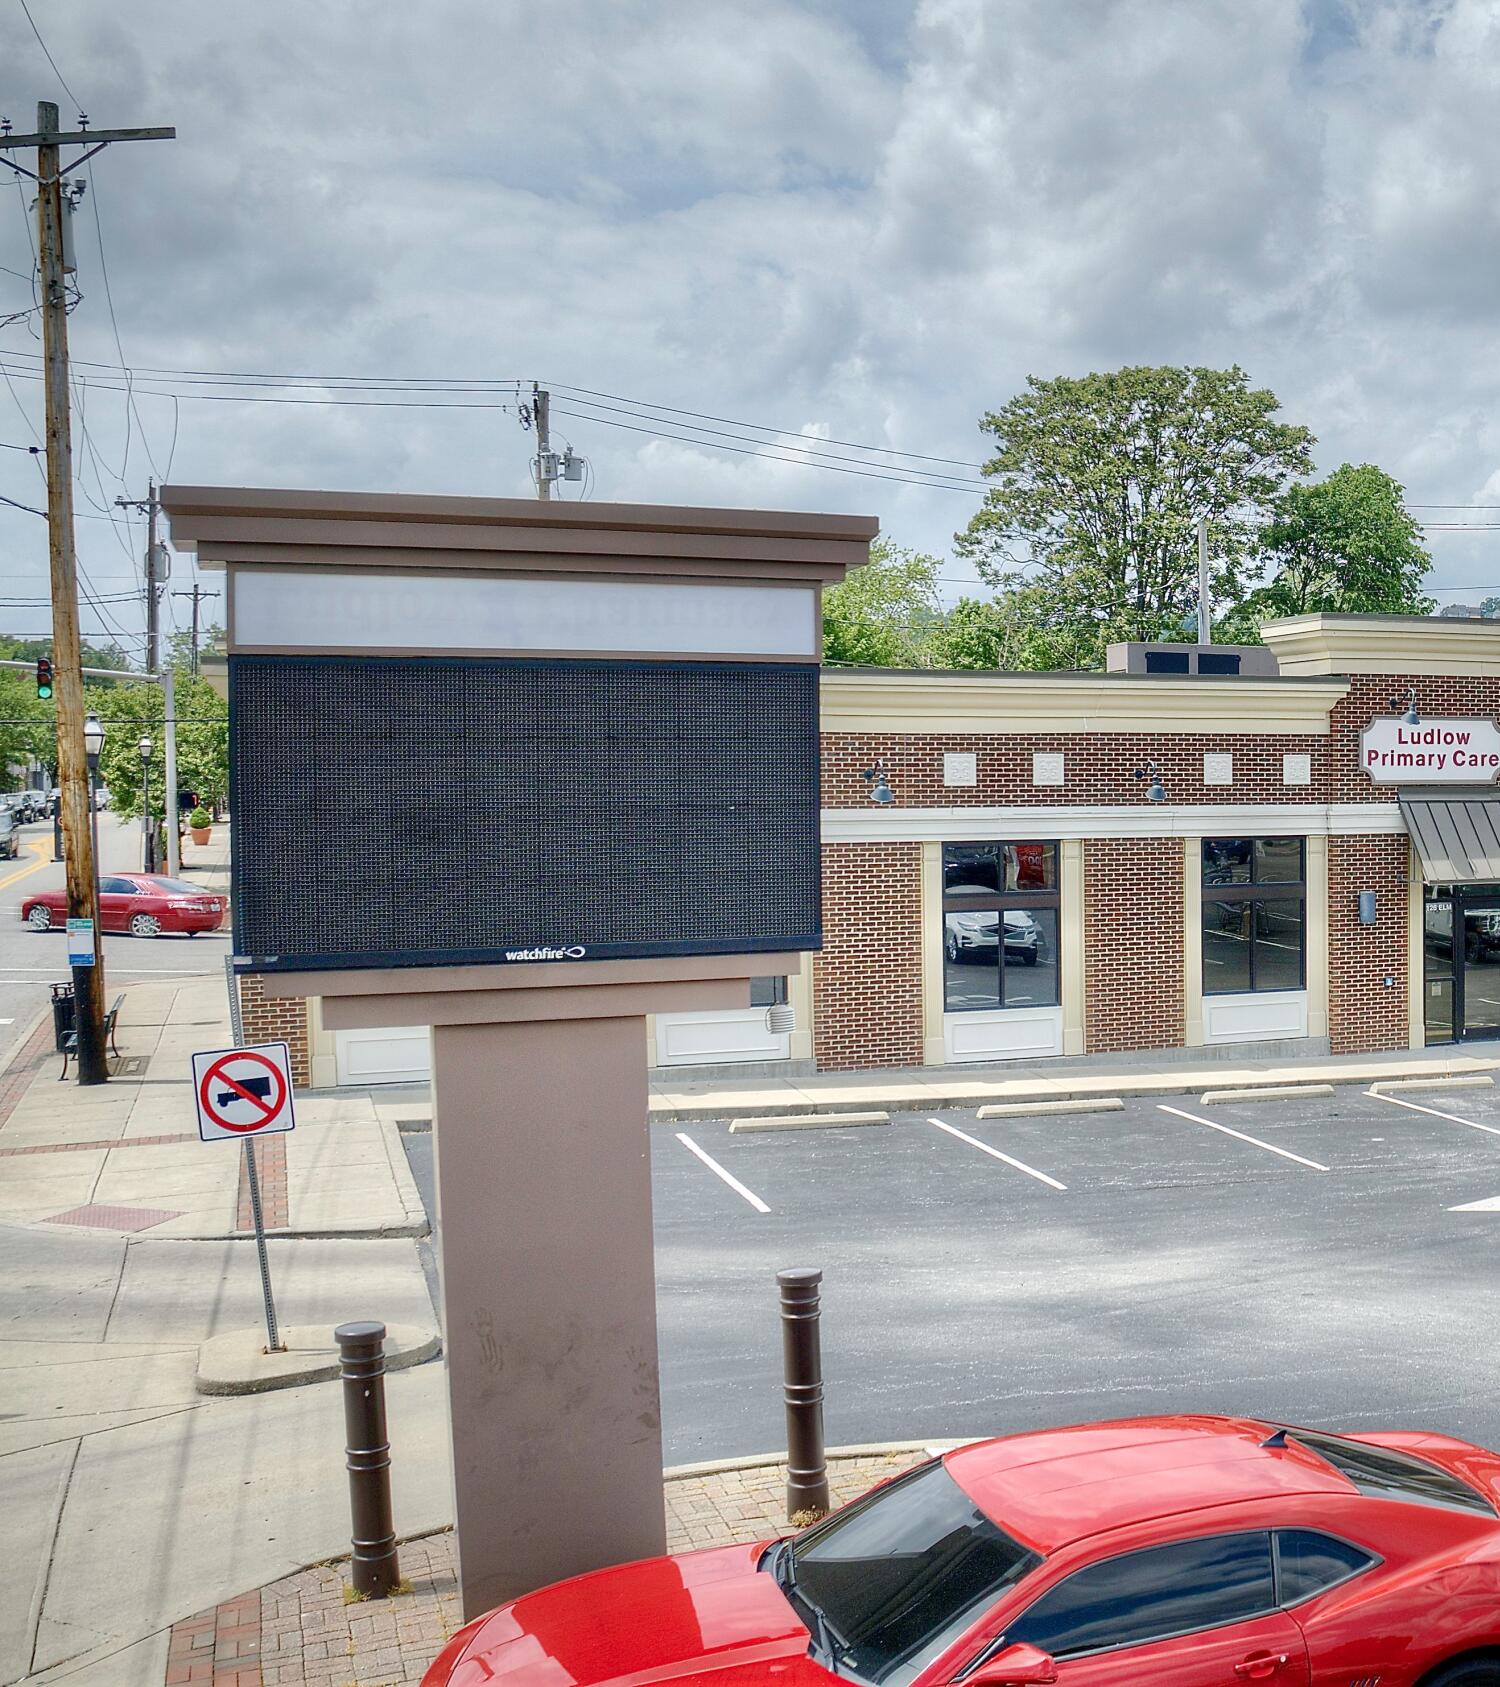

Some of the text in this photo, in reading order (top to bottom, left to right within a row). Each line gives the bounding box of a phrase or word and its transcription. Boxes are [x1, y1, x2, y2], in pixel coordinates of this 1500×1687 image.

[1398, 728, 1471, 745] Ludlow
[1367, 749, 1500, 770] Primary Care
[1438, 903, 1452, 911] ELM
[505, 947, 564, 961] watchfire
